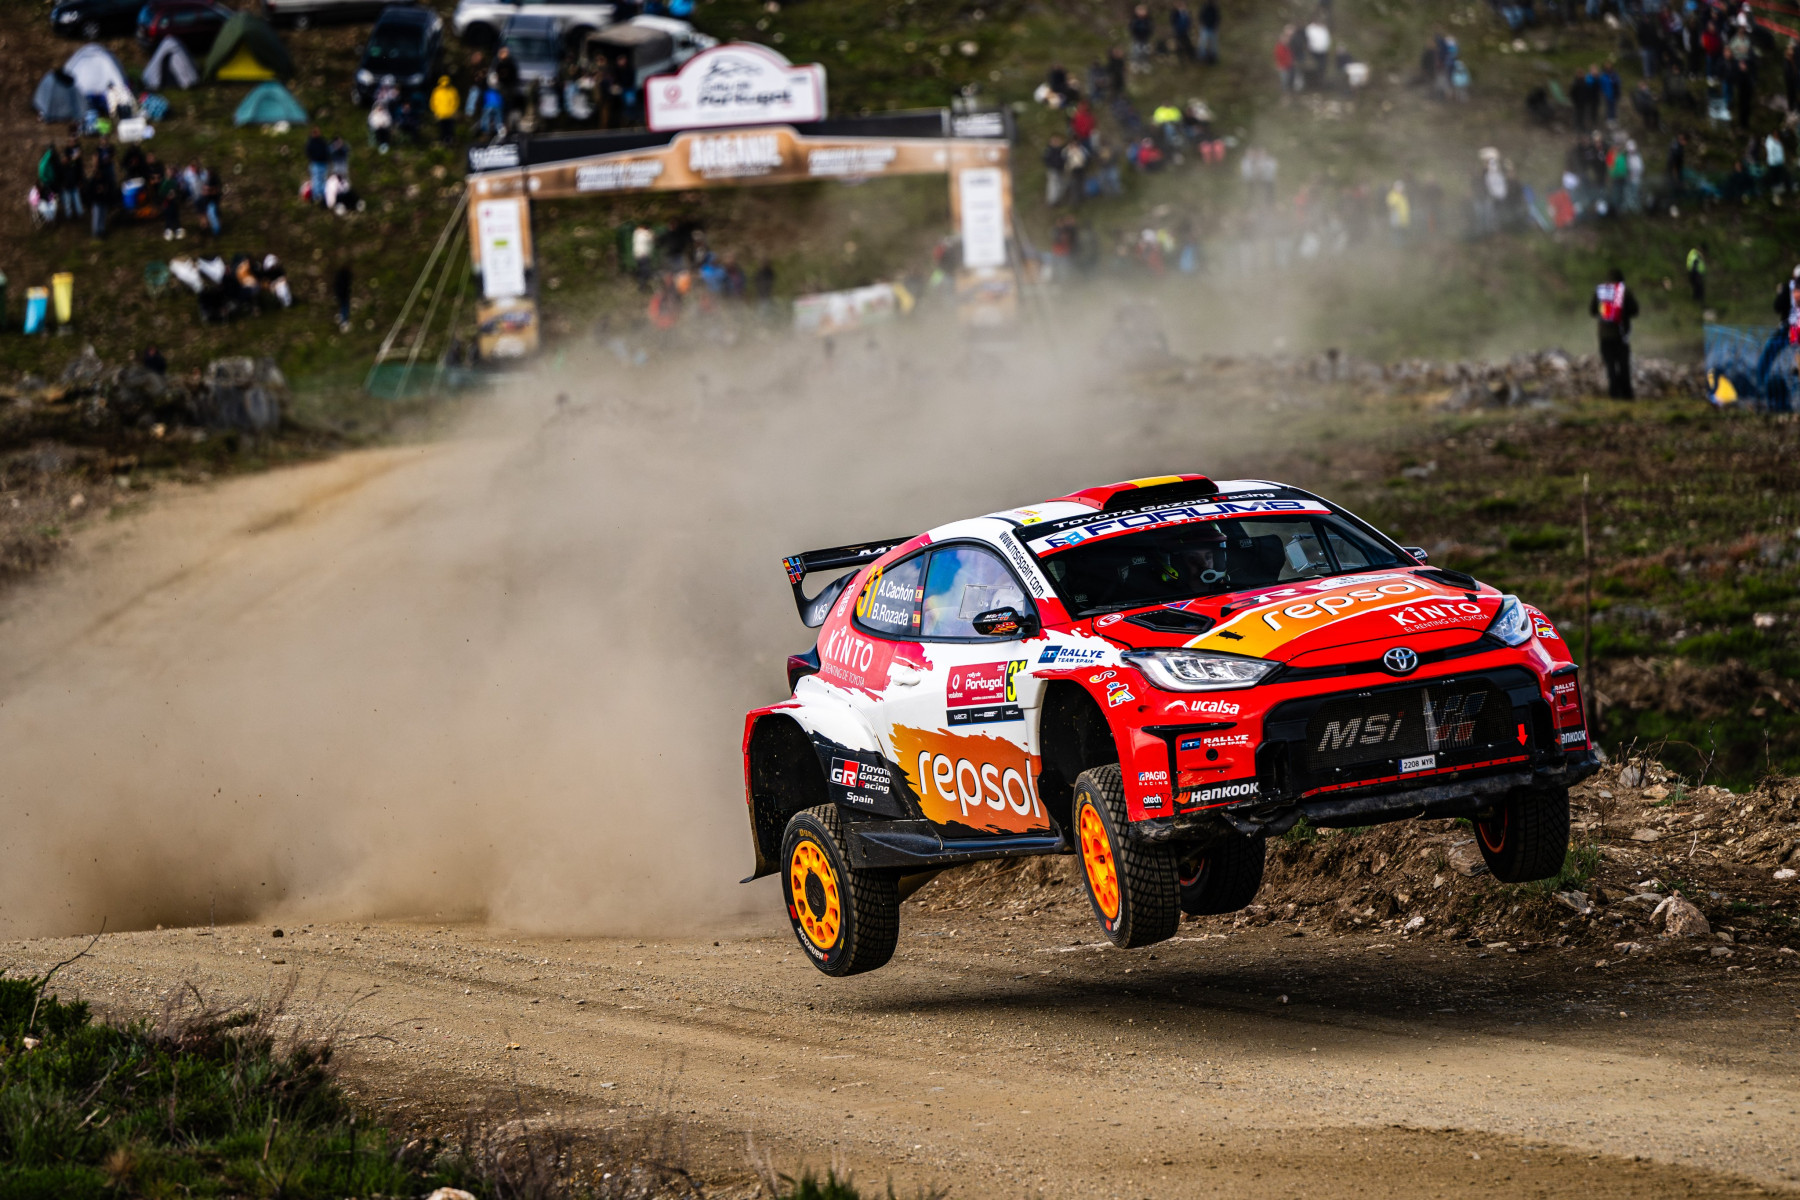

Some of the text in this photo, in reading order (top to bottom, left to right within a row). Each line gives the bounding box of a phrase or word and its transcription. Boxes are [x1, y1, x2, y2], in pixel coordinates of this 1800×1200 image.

[1053, 492, 1275, 529] TOYOTA GAZOO Racing
[1084, 501, 1305, 536] FORUM8
[856, 564, 884, 618] 31
[1262, 579, 1430, 631] repsol
[1459, 614, 1490, 622] TOYOTA
[1060, 648, 1105, 659] RALLYE
[965, 675, 1003, 691] Portugal
[1191, 700, 1240, 715] ucalsa
[1204, 734, 1249, 744] RALLYE
[1403, 757, 1434, 769] 2208 MYR
[859, 772, 890, 784] GAZOO
[1144, 771, 1167, 781] PAGID
[858, 781, 890, 794] Racing
[917, 750, 1041, 818] repsol
[846, 791, 874, 805] Spain
